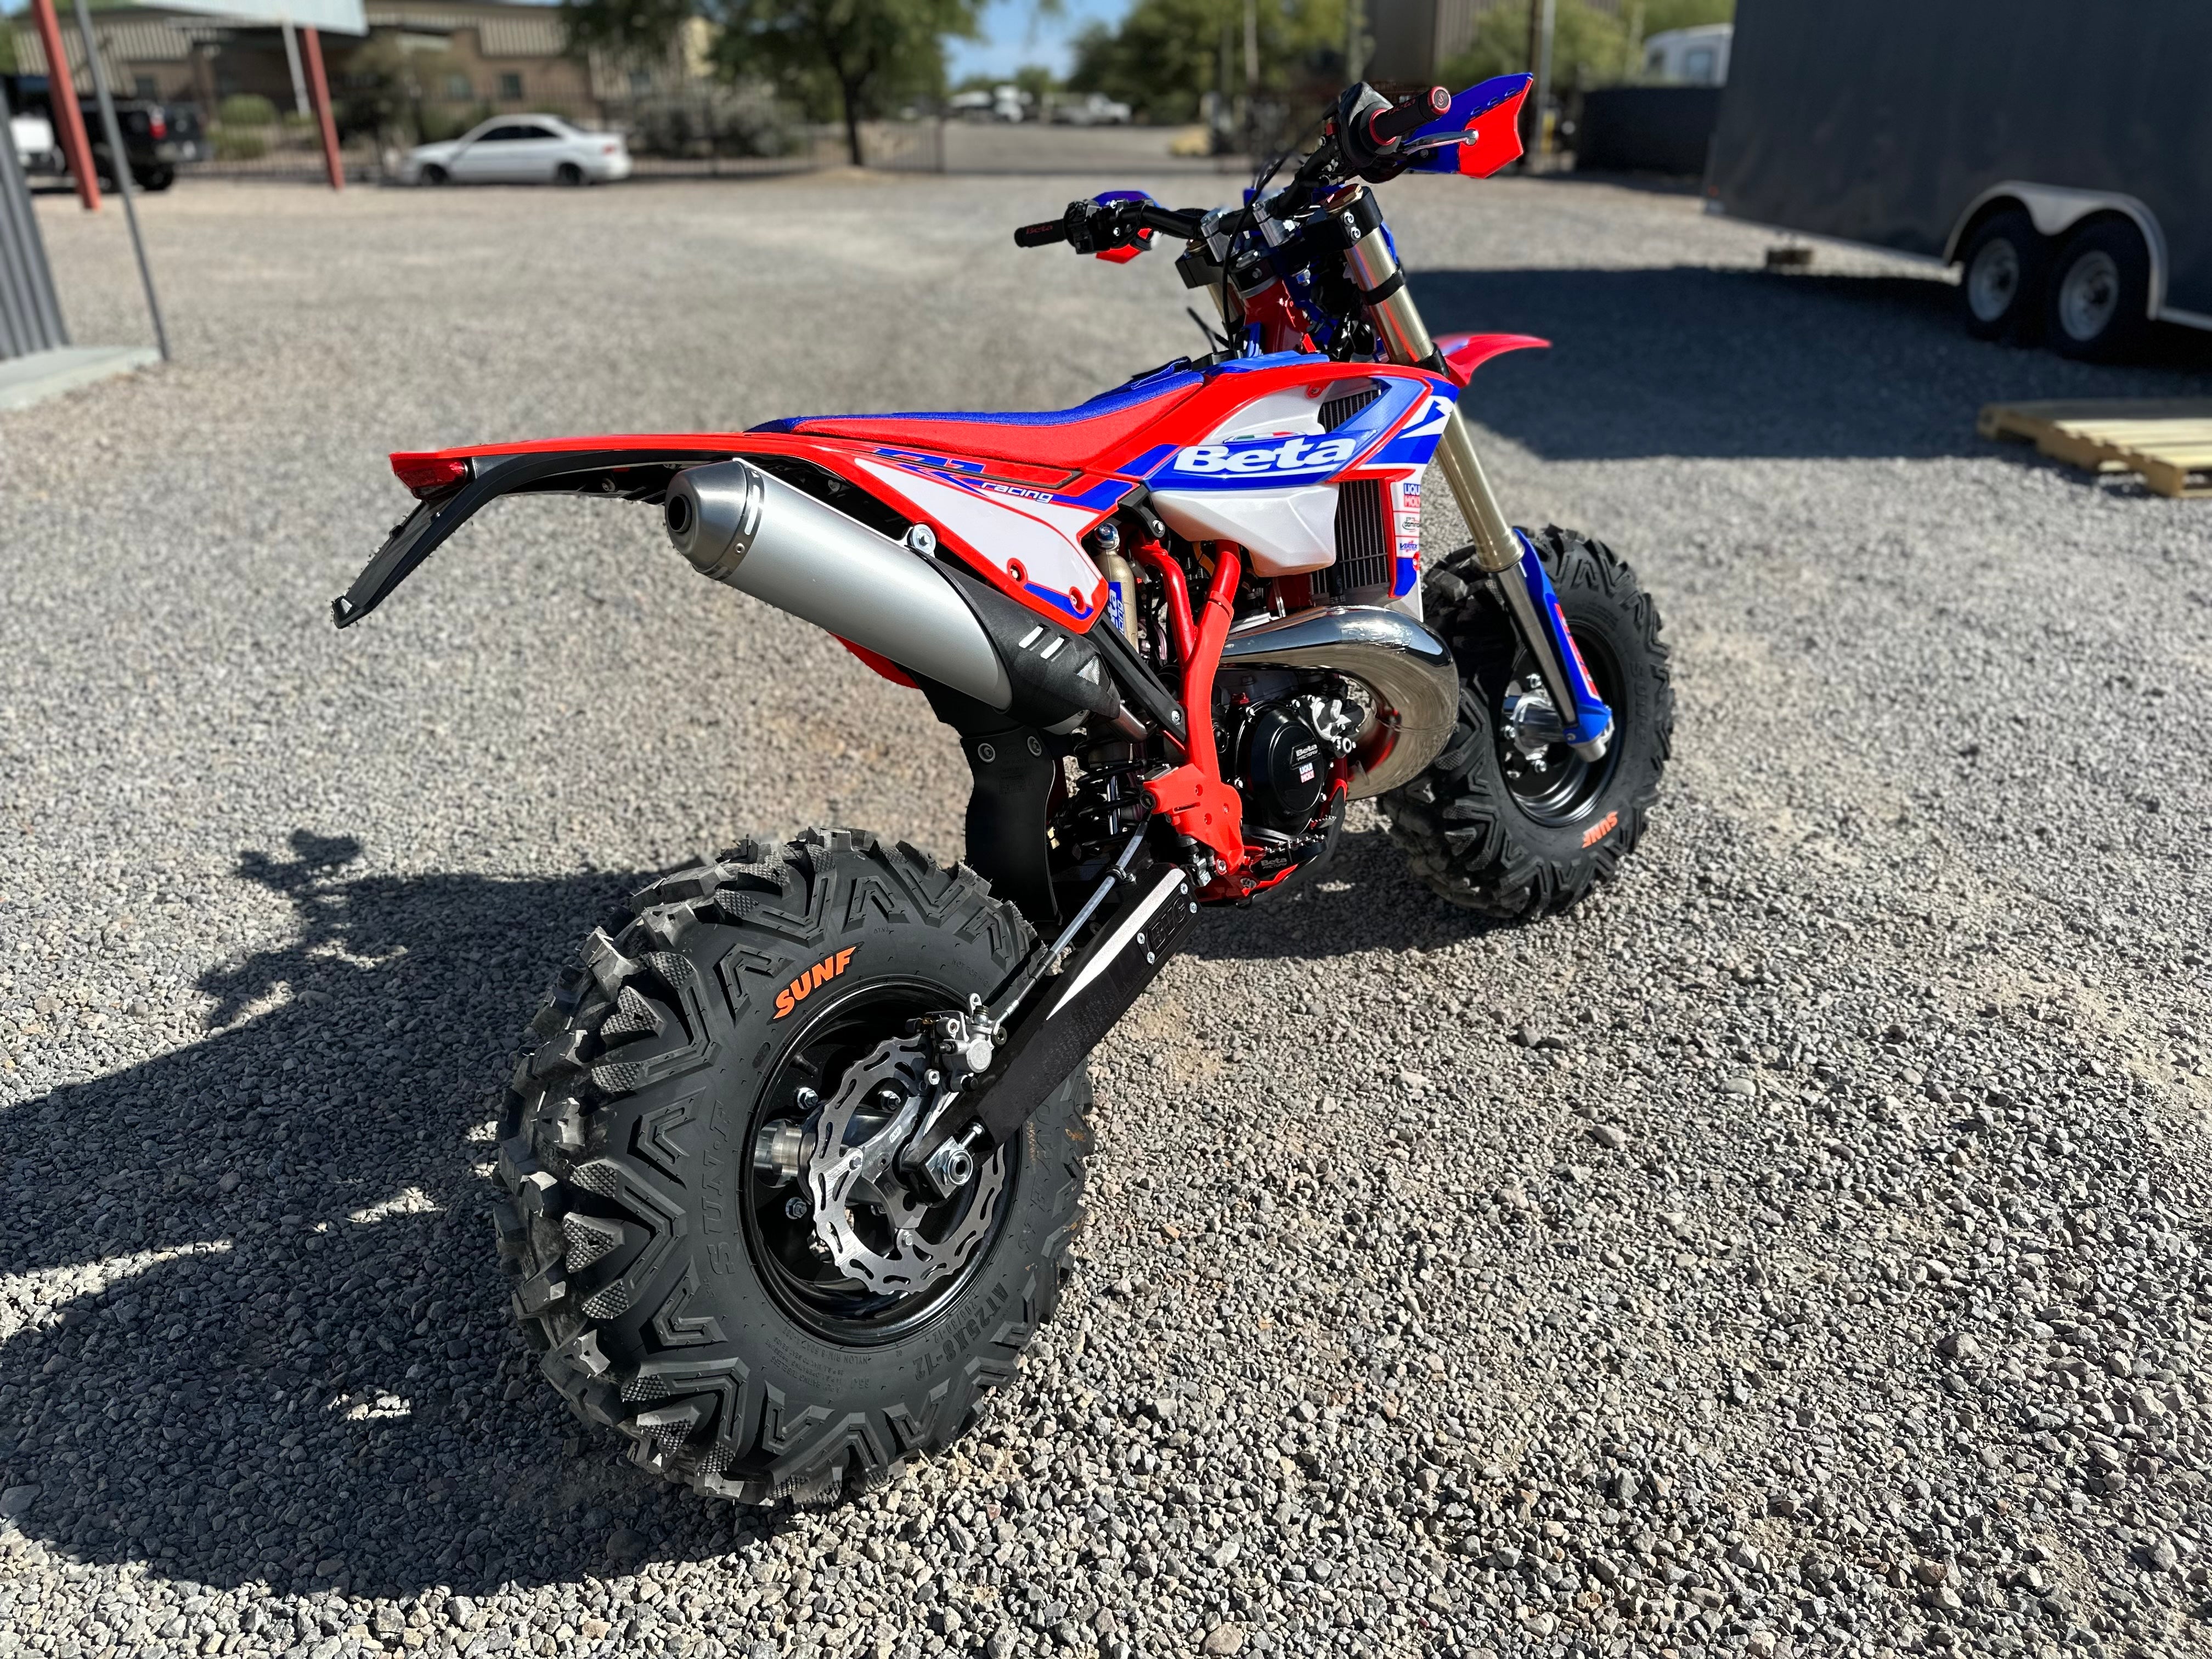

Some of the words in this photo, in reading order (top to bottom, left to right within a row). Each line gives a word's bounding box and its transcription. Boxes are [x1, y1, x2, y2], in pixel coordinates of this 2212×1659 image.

[1173, 437, 1357, 472] Beta
[981, 482, 1053, 504] racing
[1404, 483, 1420, 495] LIQU
[1404, 495, 1420, 507] MOL
[1296, 744, 1317, 757] Beta
[1582, 810, 1619, 849] SUNF
[1261, 858, 1287, 866] Beta
[772, 946, 857, 1019] SUNF
[912, 1282, 1009, 1381] AT25X8-12
[843, 1353, 867, 1366] NYLON
